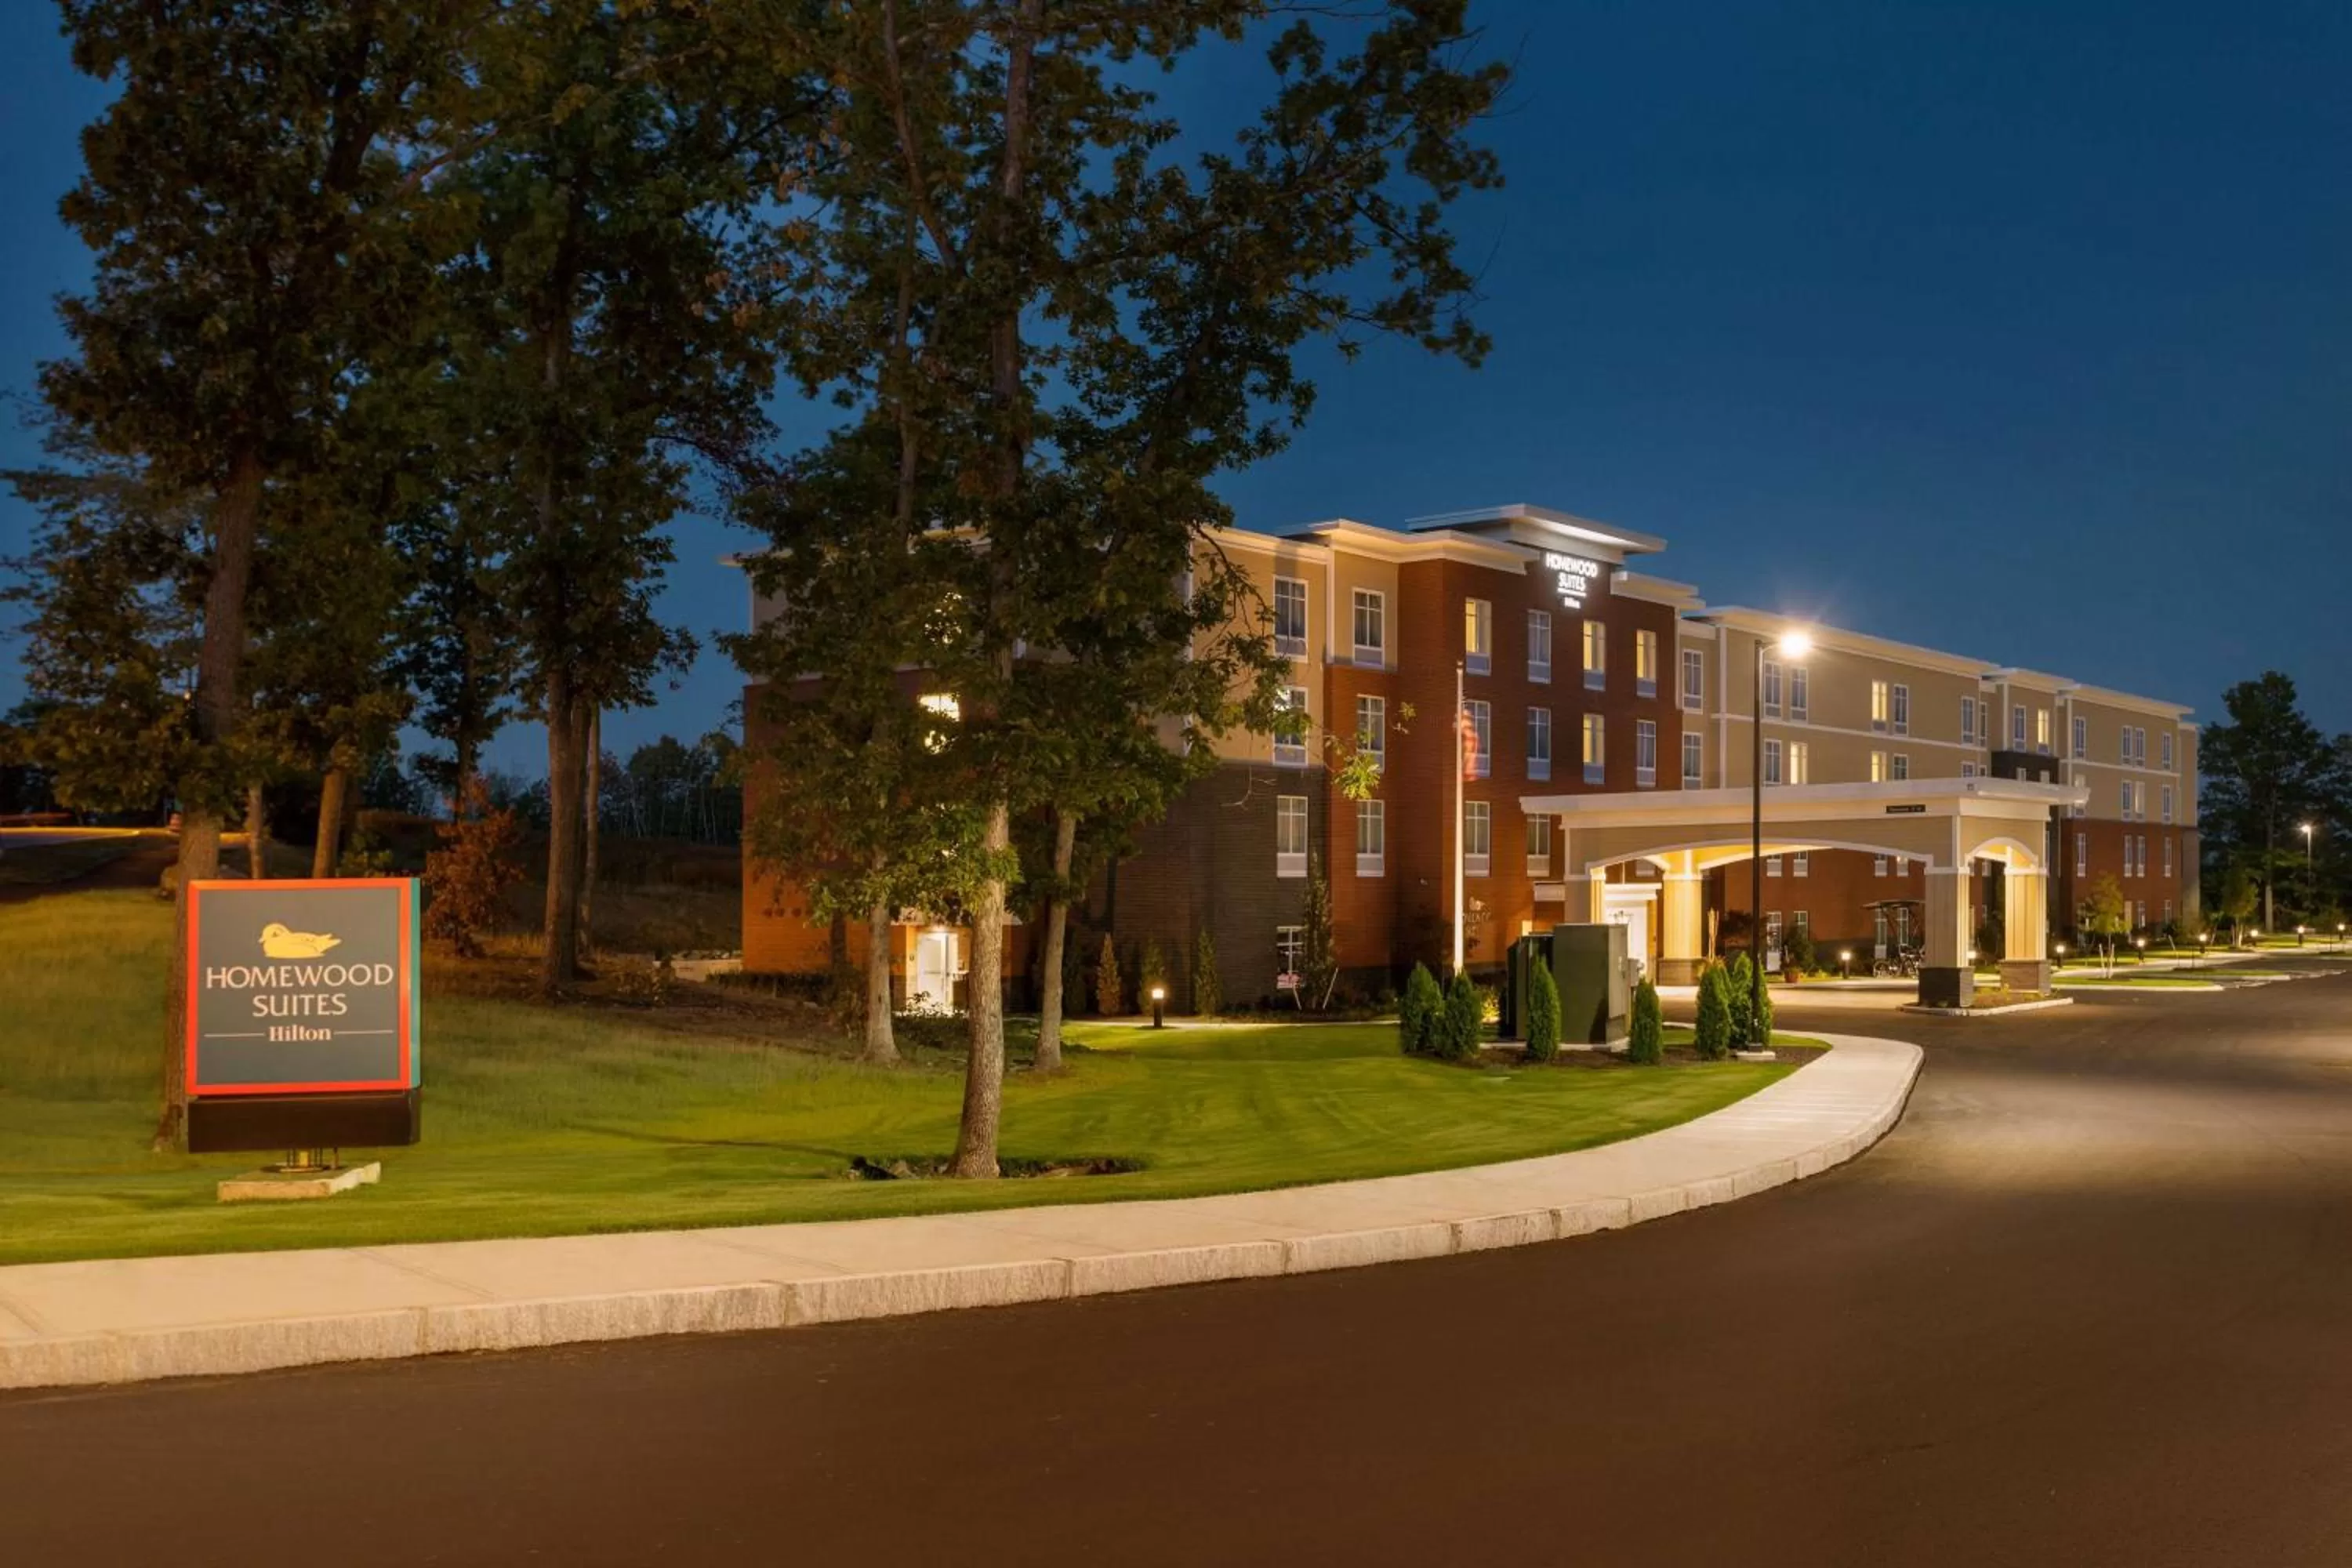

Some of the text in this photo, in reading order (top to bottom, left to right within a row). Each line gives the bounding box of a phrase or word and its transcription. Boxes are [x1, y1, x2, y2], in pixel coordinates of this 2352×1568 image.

[205, 964, 394, 989] HOMEWOOD
[252, 993, 347, 1017] SUITES
[269, 1024, 332, 1042] Hilton
